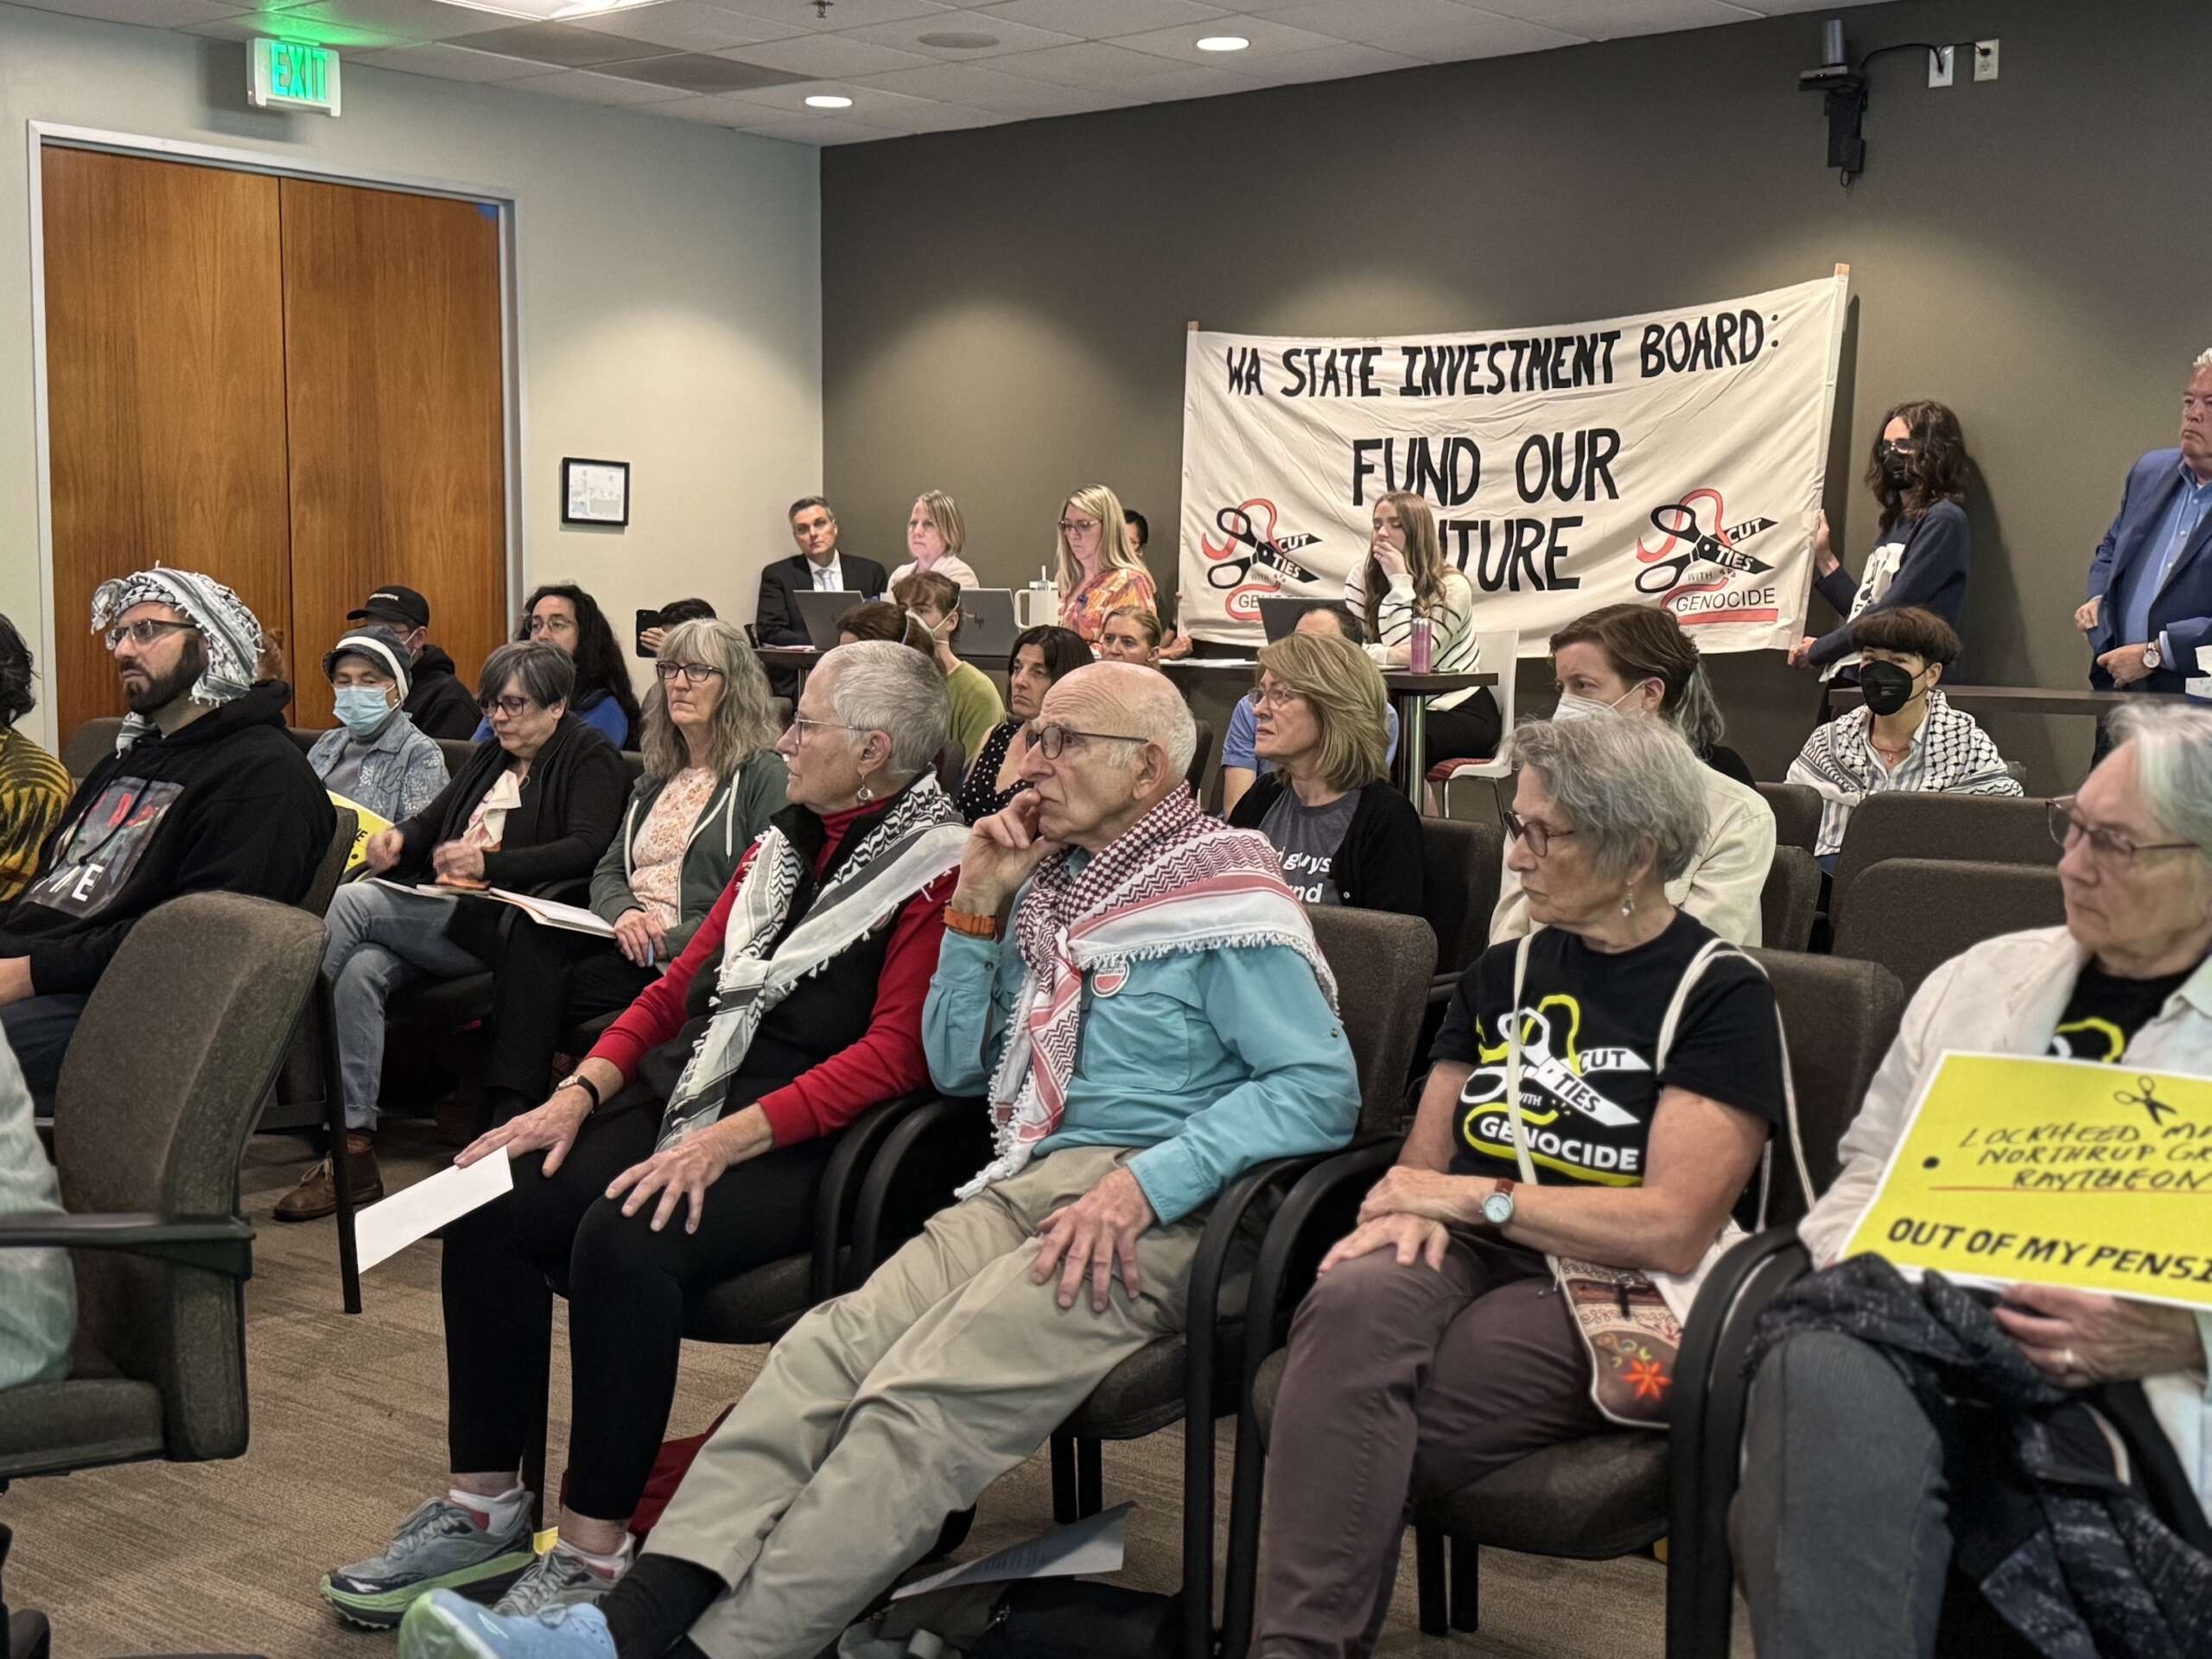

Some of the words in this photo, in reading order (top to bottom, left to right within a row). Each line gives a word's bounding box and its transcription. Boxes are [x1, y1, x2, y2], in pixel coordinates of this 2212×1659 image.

[270, 42, 329, 102] EXIT
[1226, 346, 1264, 396] WA
[1281, 346, 1382, 397] STATE
[1400, 330, 1621, 397] INVESTMENT
[1640, 308, 1779, 378] BOARD:
[1353, 436, 1480, 506] FUND
[1516, 428, 1621, 503] OUR
[1278, 534, 1309, 553] CUT
[1728, 518, 1762, 544] CUT
[1272, 554, 1302, 578] TIES
[1438, 516, 1583, 592] TURE
[1716, 544, 1754, 571] TIES
[1688, 570, 1713, 582] WITH
[1676, 588, 1776, 612] GENOCIDE
[1282, 852, 1332, 874] guys
[1288, 882, 1324, 903] nd
[1579, 1050, 1626, 1071] CUT
[1521, 1092, 1542, 1106] ITH
[1554, 1073, 1600, 1113] TIES
[1480, 1116, 1639, 1170] GENOCIDE
[1959, 1122, 2141, 1148] LOCKHEED
[1978, 1145, 2157, 1166] NORTHRUP
[2012, 1168, 2212, 1192] RAYTHEON
[1887, 1217, 1966, 1249] OUT
[1966, 1230, 2018, 1255] OF
[2016, 1236, 2088, 1266] MY
